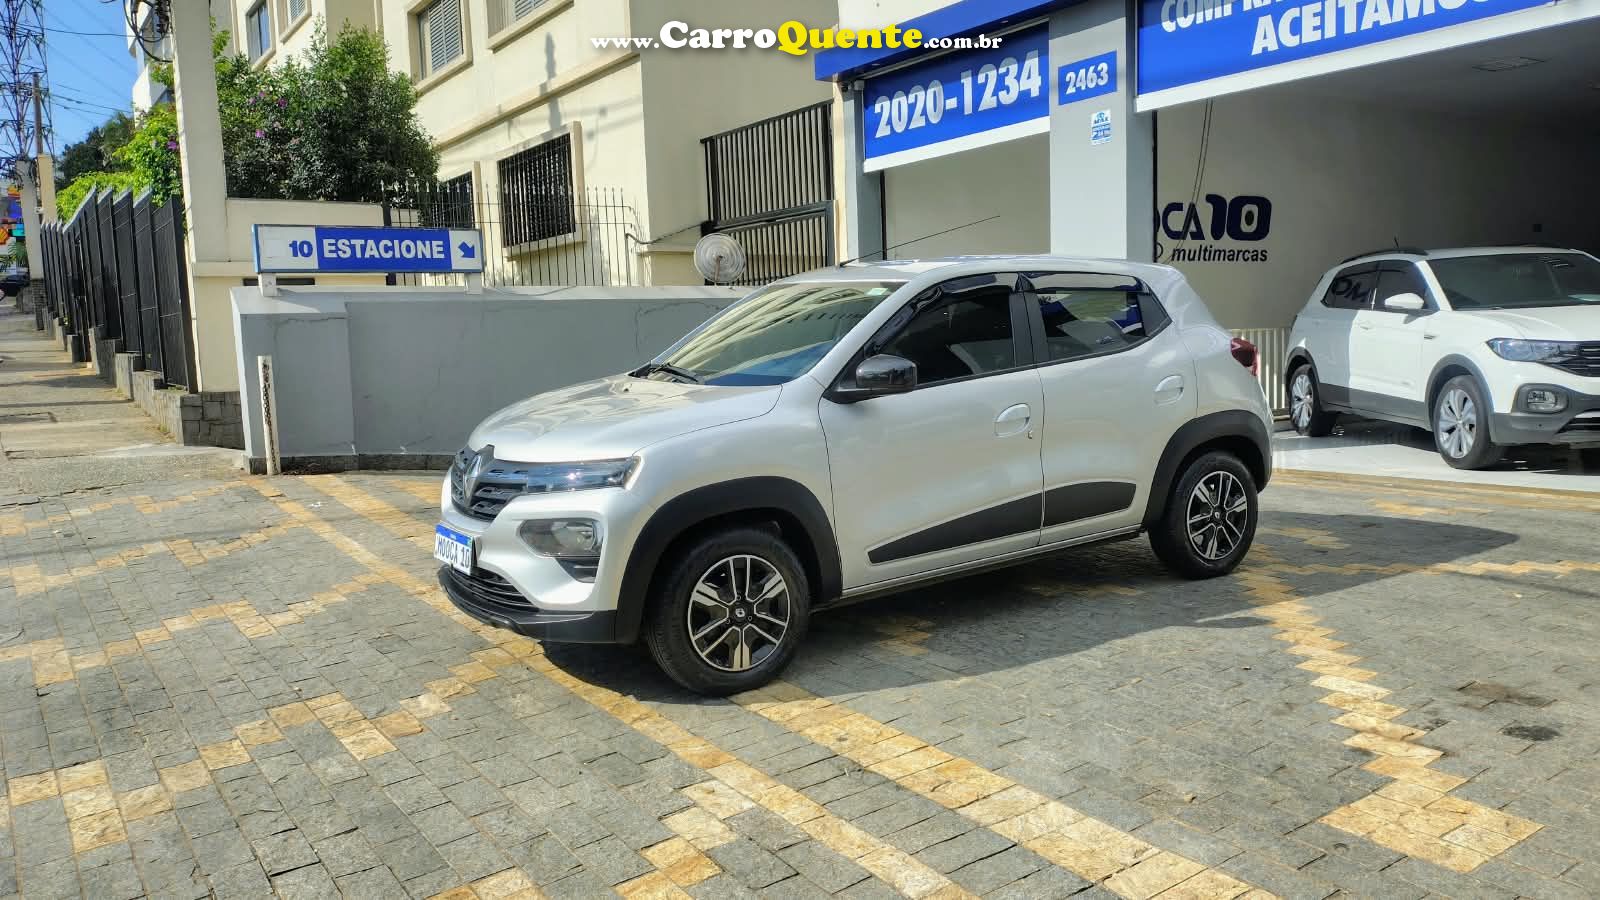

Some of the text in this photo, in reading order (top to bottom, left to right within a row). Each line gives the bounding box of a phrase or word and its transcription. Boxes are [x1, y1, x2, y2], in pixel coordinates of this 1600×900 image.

[1065, 62, 1109, 95] 2463
[874, 49, 1042, 139] 2020-1234
[288, 239, 445, 259] 10 ESTACIONE
[1171, 244, 1268, 262] multimarcas
